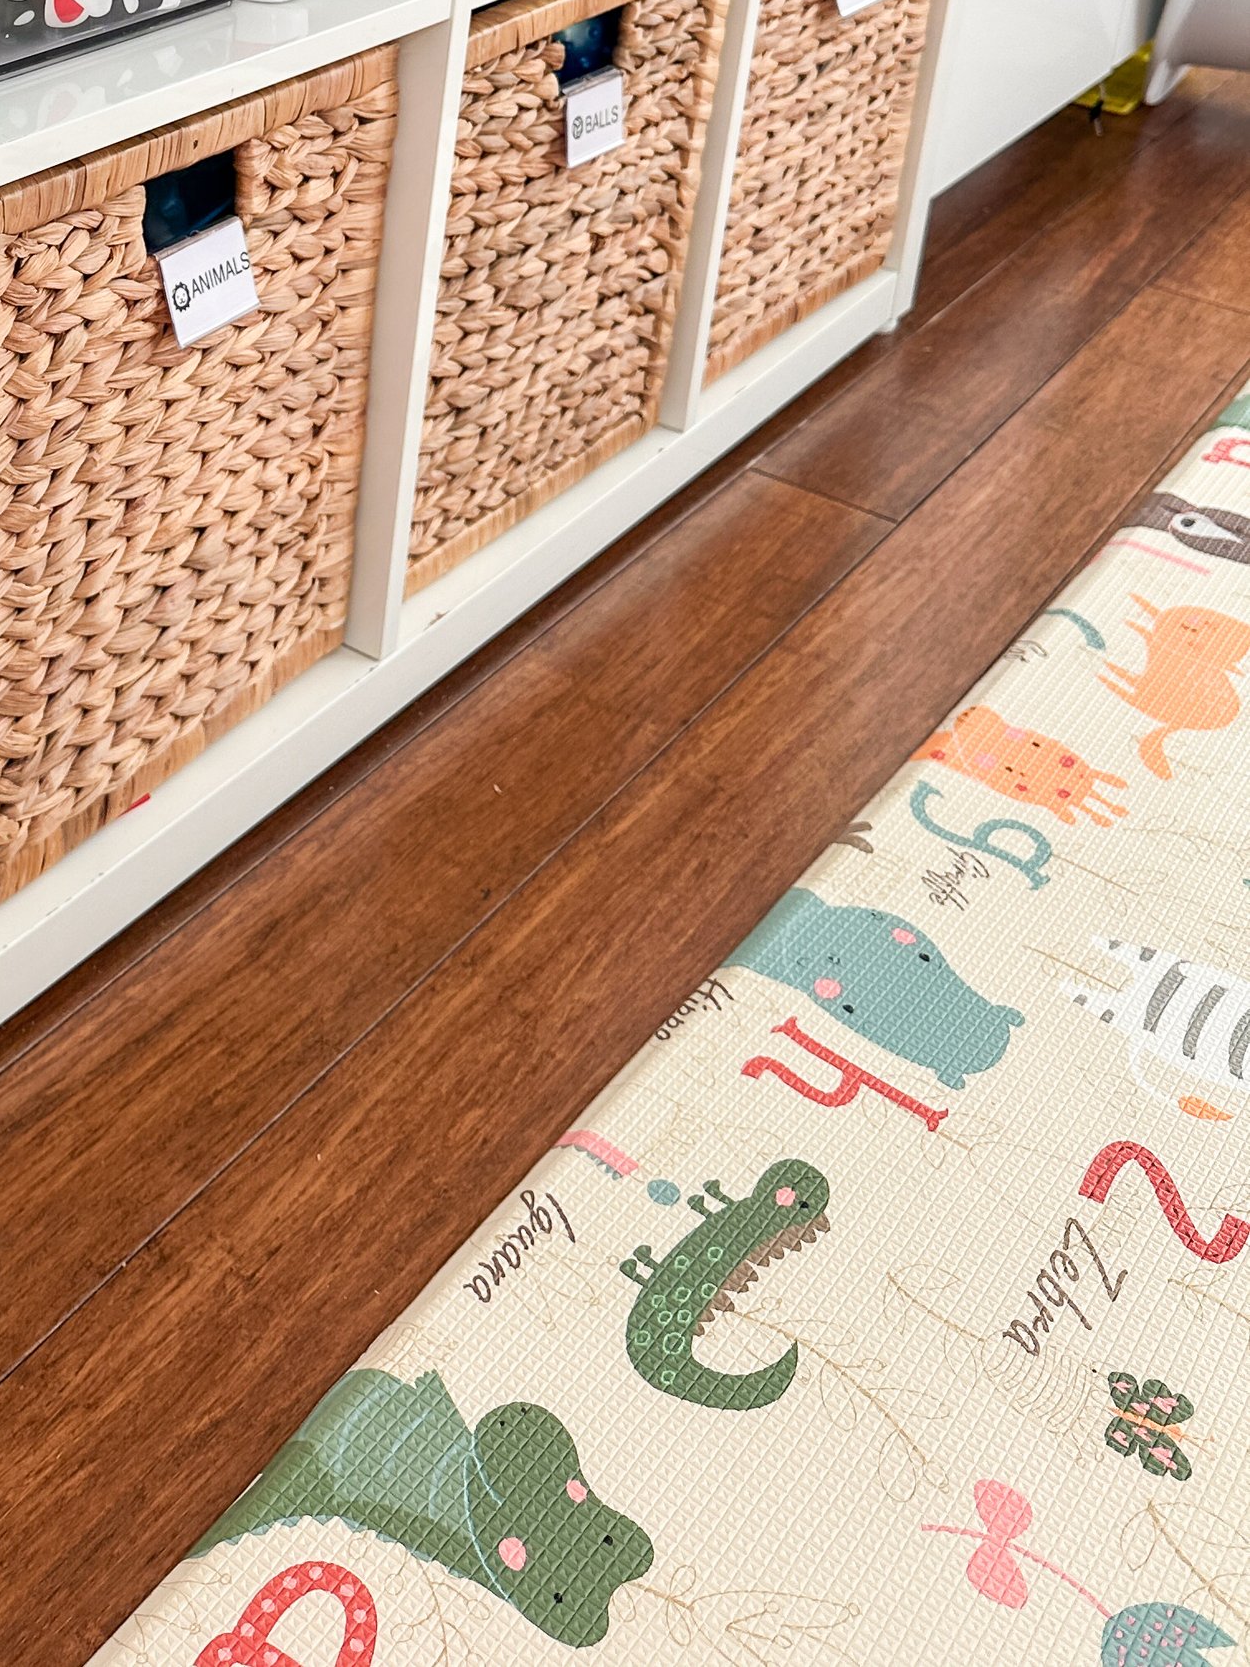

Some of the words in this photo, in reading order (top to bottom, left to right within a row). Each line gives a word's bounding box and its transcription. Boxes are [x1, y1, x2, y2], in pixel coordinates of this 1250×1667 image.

[585, 105, 619, 134] BALLS
[191, 251, 251, 298] ANIMALS
[462, 1189, 576, 1303] Iguana
[1002, 1217, 1128, 1356] Zebra
